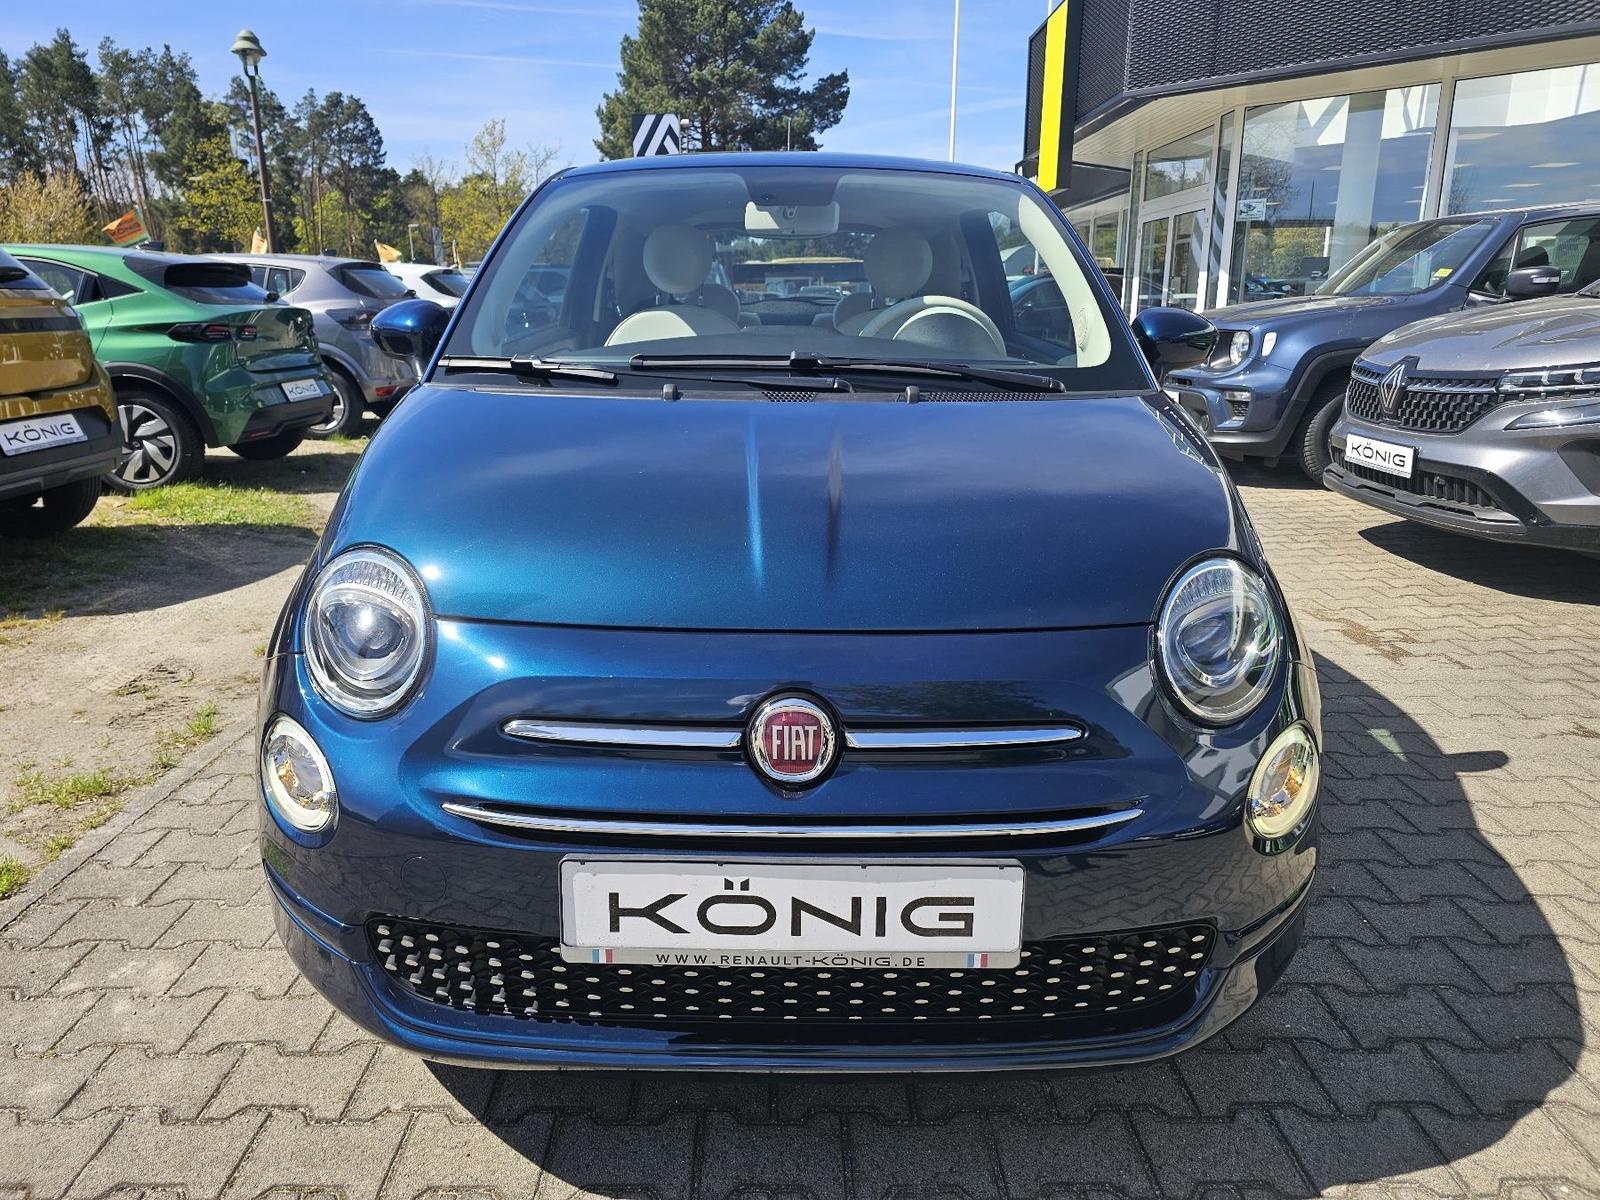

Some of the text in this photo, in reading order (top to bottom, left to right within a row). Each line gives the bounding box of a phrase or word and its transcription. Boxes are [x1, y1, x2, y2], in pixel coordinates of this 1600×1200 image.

[4, 423, 76, 446] KÖNIG
[1351, 442, 1406, 468] KÖNIG
[771, 725, 818, 761] FIAT
[608, 878, 975, 937] KÖNIG
[656, 953, 926, 967] WWW.RENAULT-KÖNIG.DE
